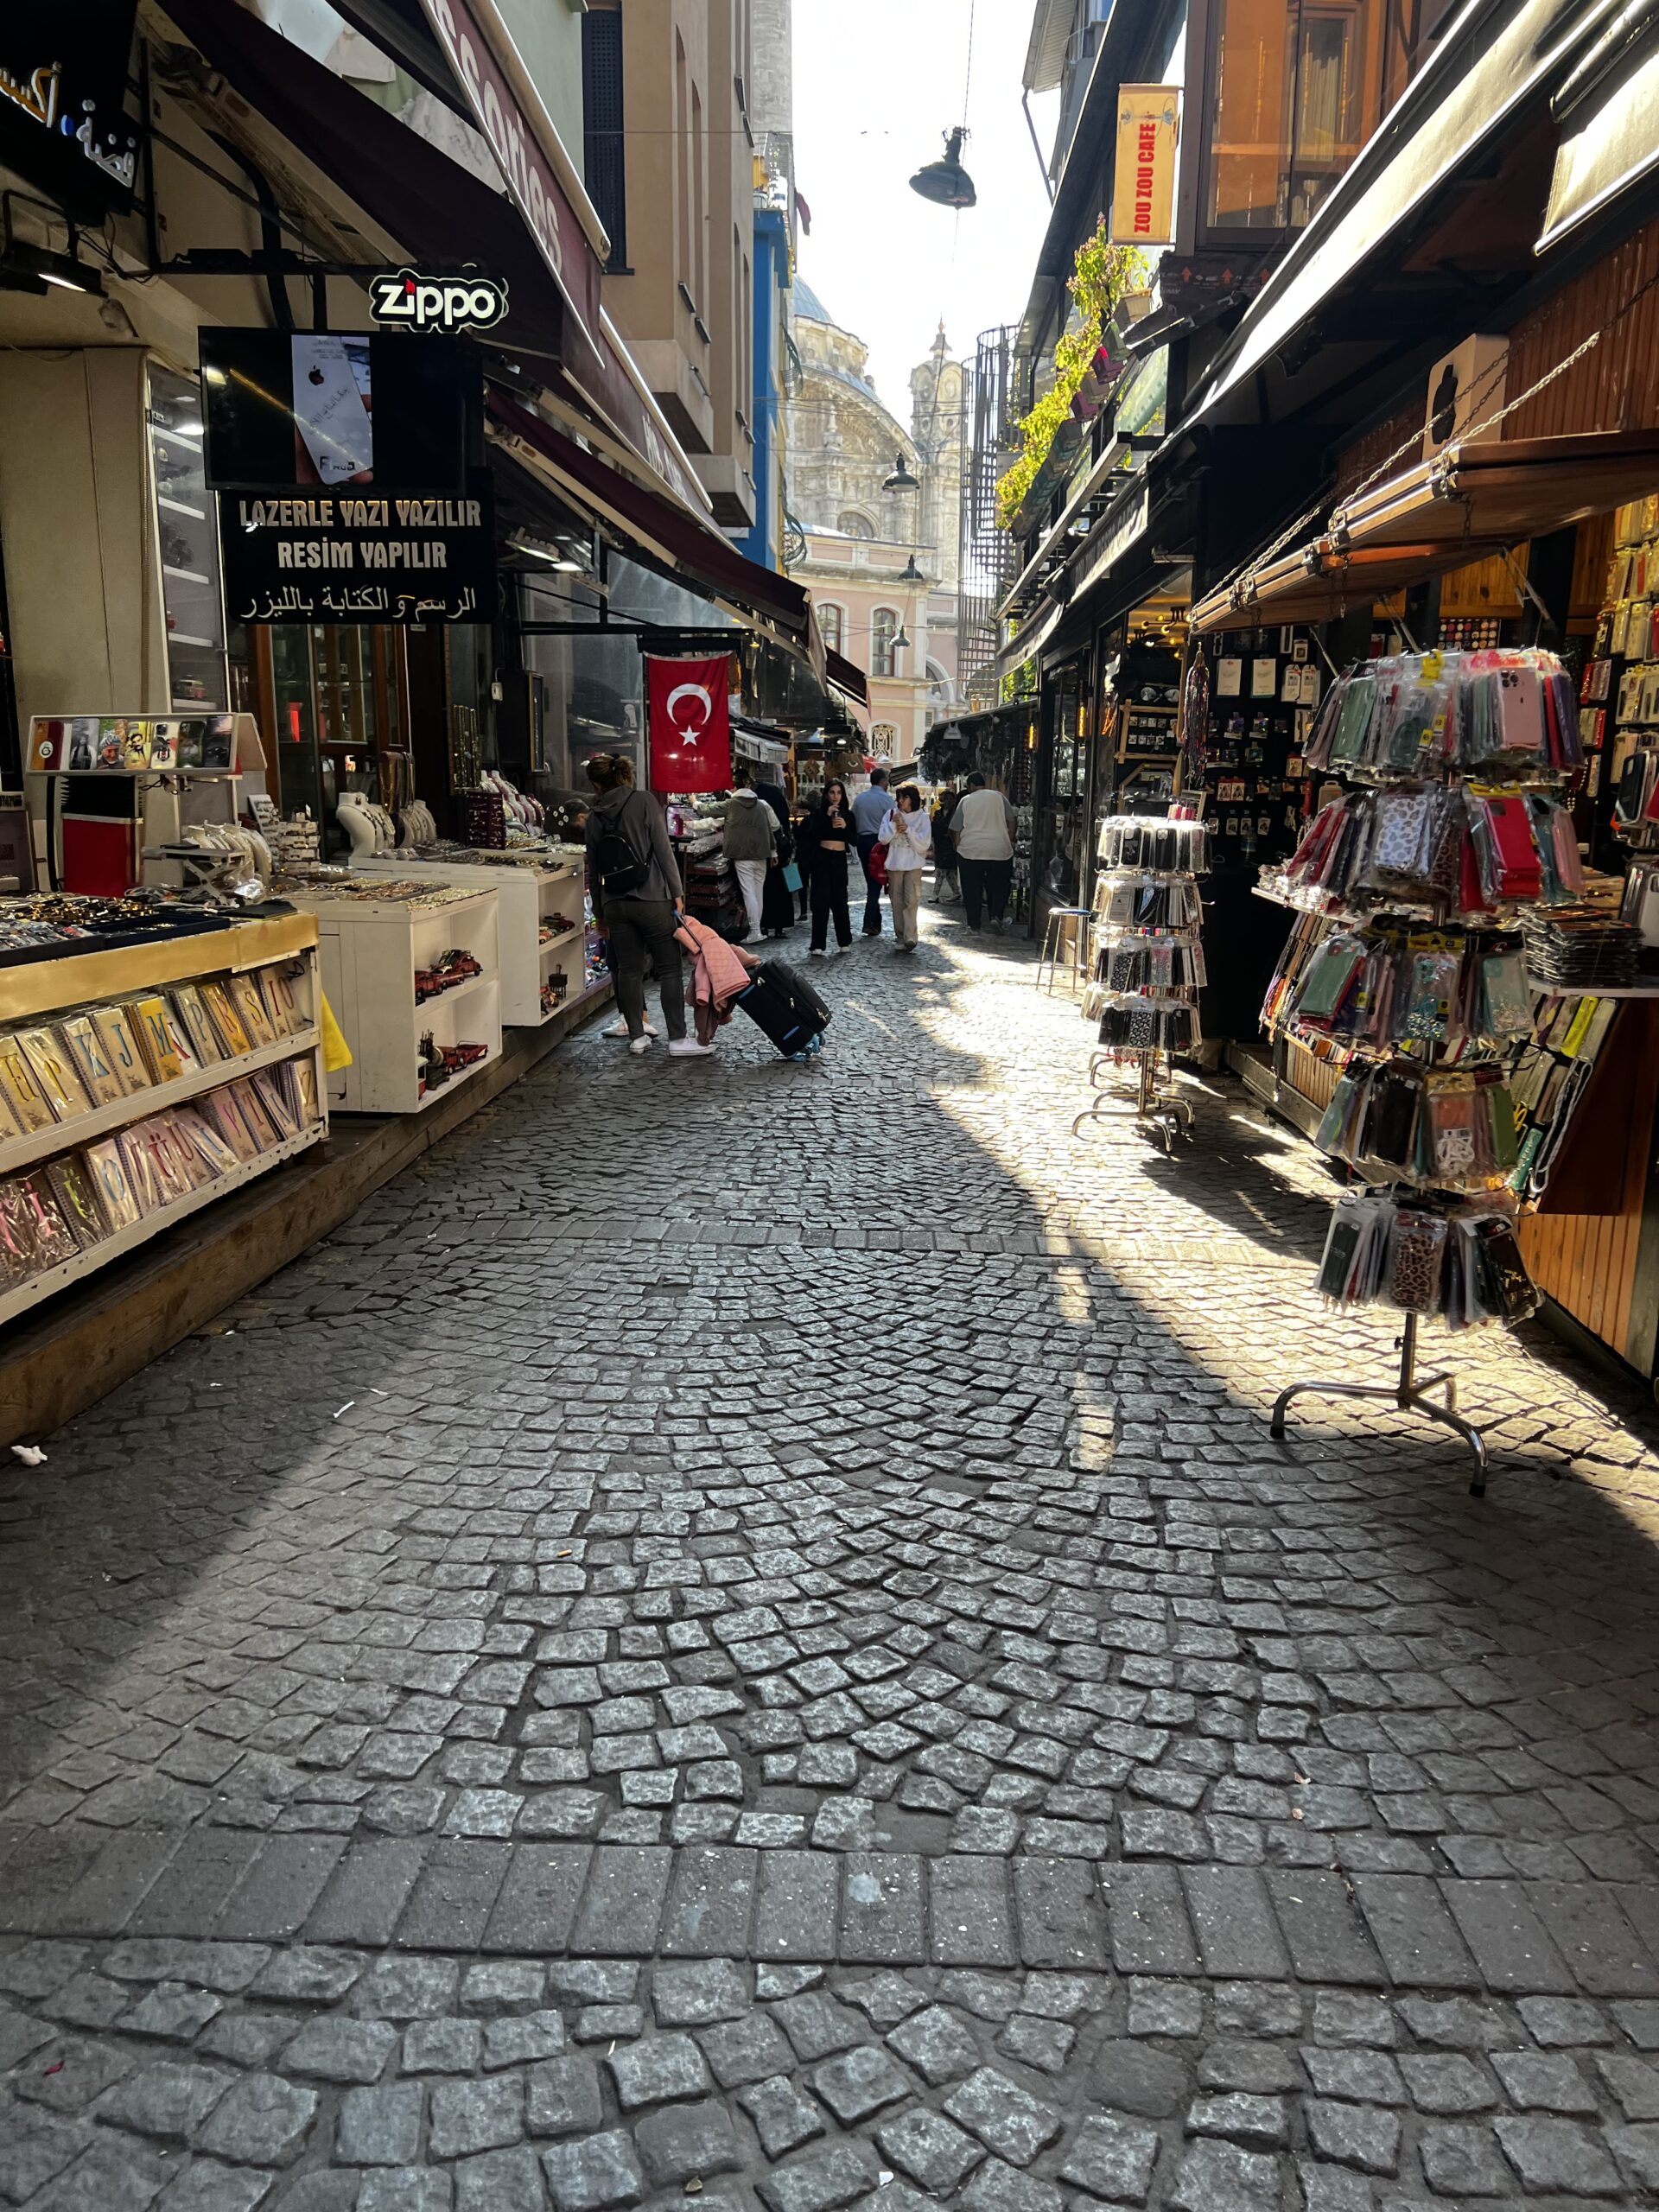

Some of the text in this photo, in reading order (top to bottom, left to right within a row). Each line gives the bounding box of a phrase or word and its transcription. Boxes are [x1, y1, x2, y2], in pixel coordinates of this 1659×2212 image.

[1134, 123, 1156, 233] ZOU ZOU CAFE
[239, 499, 482, 527] LAZERLE YAZI YAZILIR
[277, 537, 448, 569] RESİM YAPILIR
[240, 585, 315, 619] بالليزر
[321, 584, 389, 617] الكتابة
